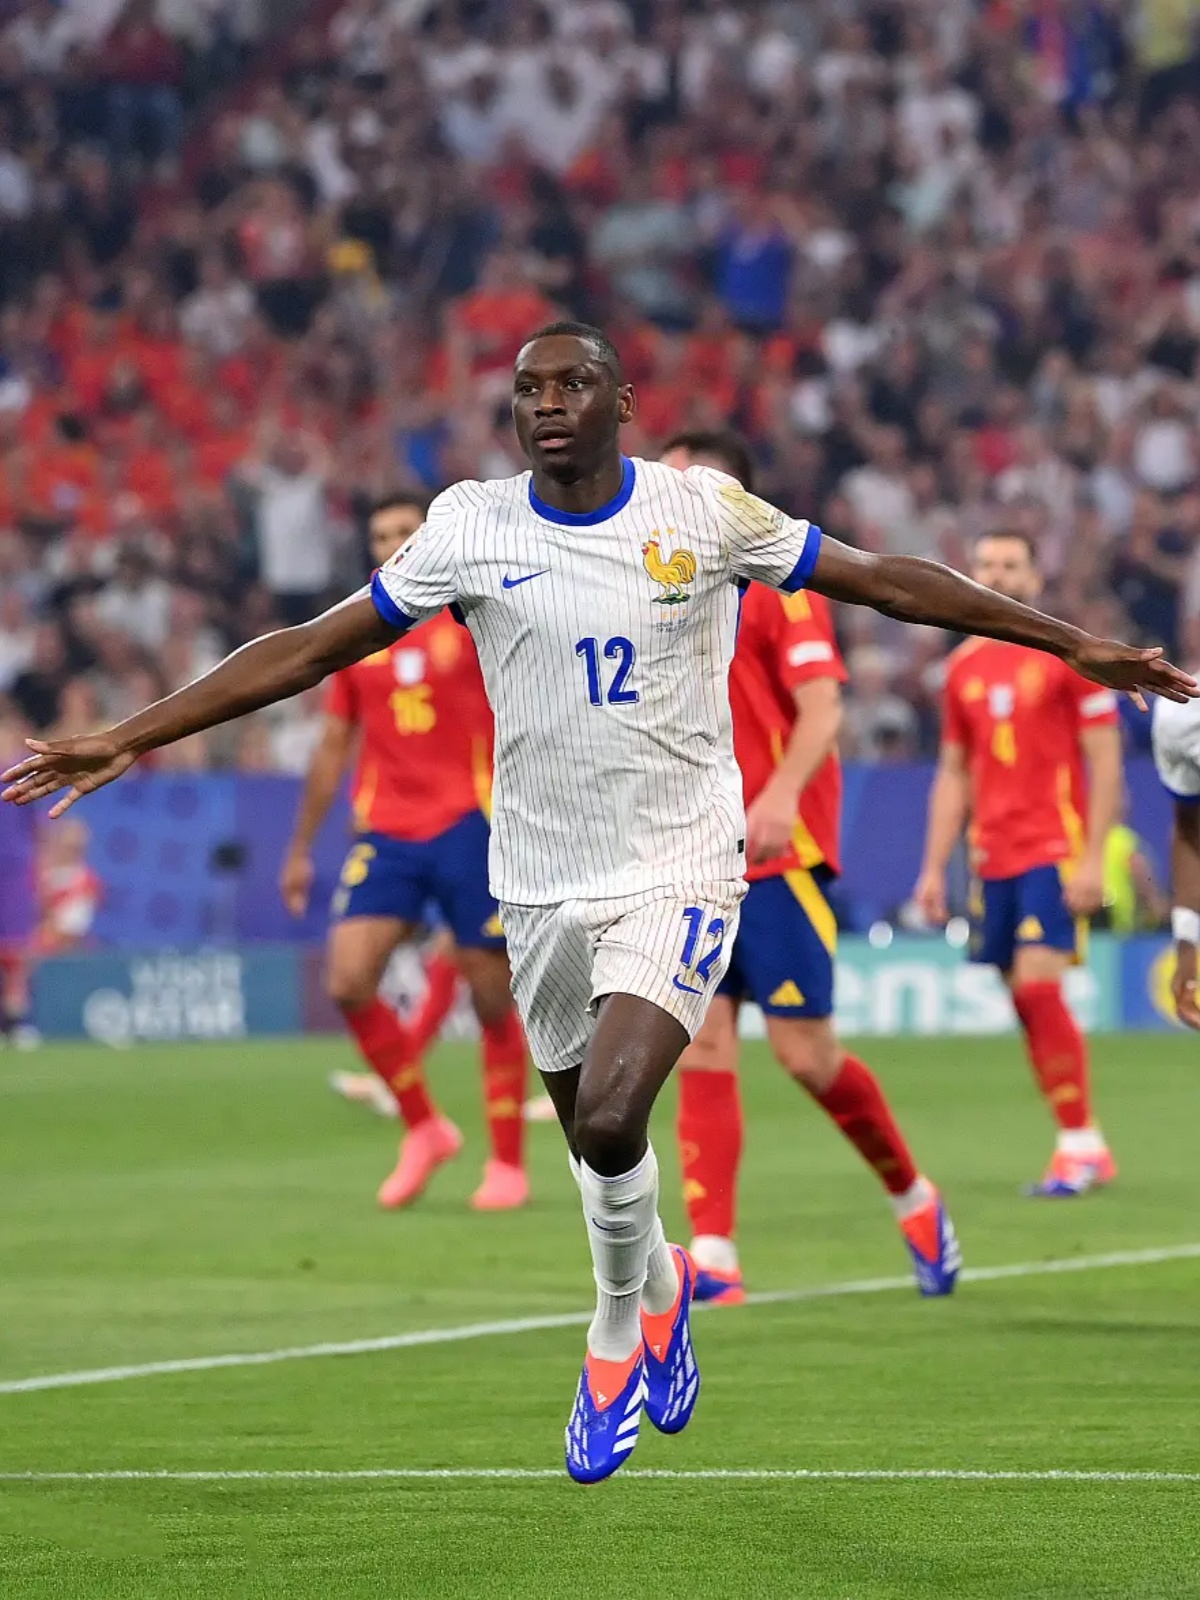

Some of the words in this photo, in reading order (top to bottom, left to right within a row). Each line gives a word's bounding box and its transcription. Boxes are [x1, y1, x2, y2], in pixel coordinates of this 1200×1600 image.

[575, 636, 640, 706] 12
[388, 683, 437, 736] 16
[991, 723, 1017, 769] 4
[680, 906, 725, 988] 12
